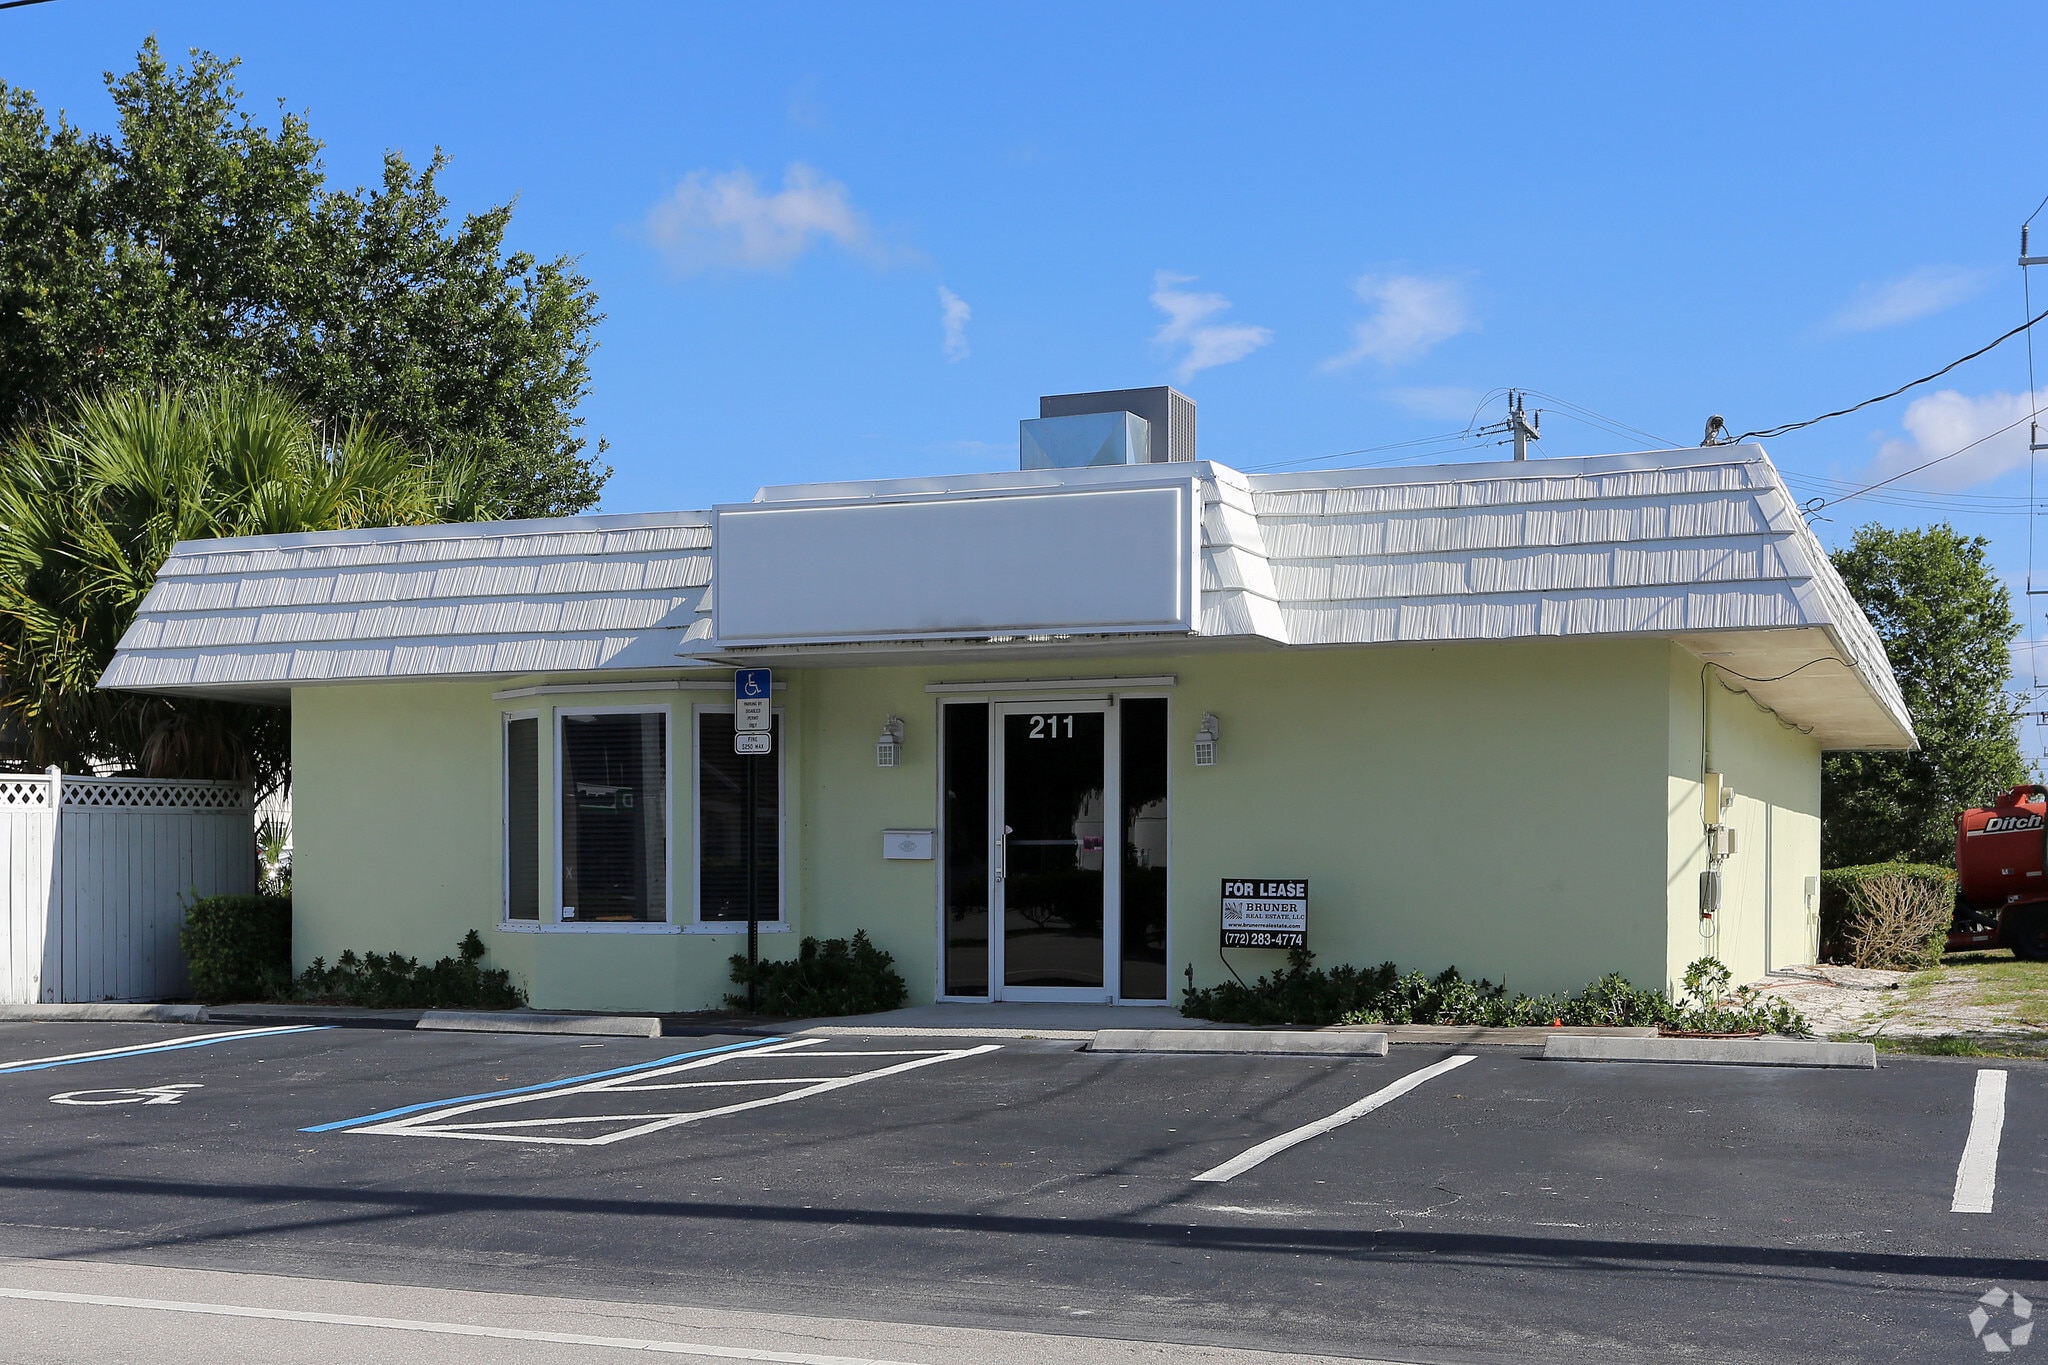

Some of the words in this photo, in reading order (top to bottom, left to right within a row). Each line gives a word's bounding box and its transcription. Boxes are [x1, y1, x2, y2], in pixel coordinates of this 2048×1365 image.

[1029, 715, 1073, 739] 211
[1985, 814, 2042, 832] Ditch
[1225, 882, 1254, 896] FOR
[1260, 883, 1305, 897] LEASE
[1246, 903, 1297, 912] BRUNER
[1225, 932, 1249, 945] (772)
[1251, 933, 1302, 946] 283-4774
